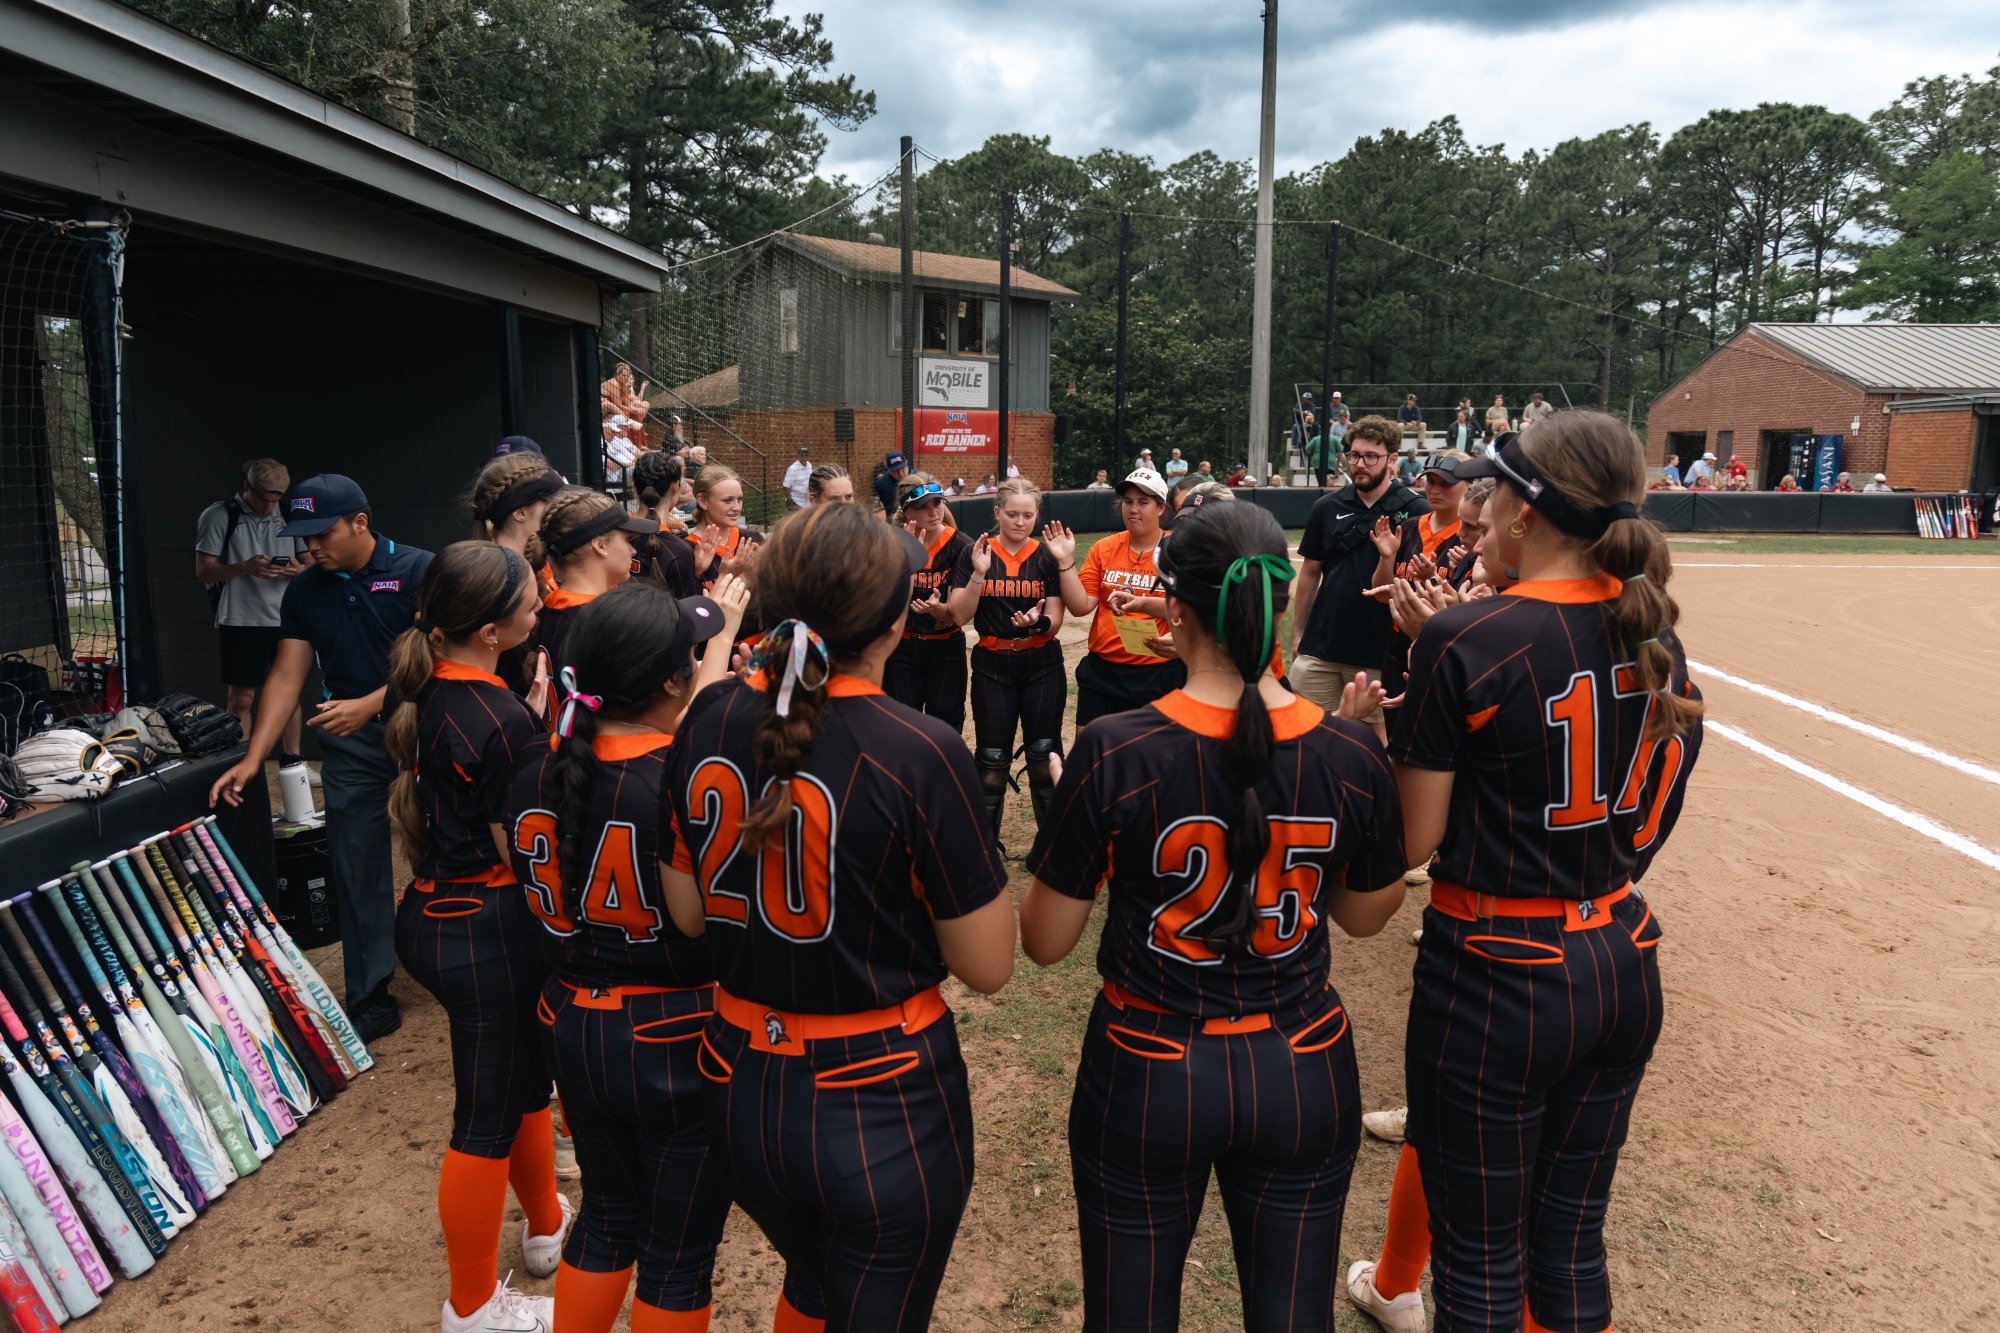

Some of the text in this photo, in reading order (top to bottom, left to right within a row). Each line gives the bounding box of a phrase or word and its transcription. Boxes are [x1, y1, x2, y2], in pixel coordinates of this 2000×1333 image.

[926, 370, 983, 389] MOBILE
[934, 364, 967, 372] UNIVERSITY
[925, 434, 986, 446] RED BANNER
[946, 412, 967, 424] NAIA
[370, 579, 401, 592] NAIA
[514, 808, 663, 944] 34
[686, 756, 837, 944] 20
[1147, 814, 1338, 966] 25
[225, 1008, 296, 1129] UNLIMITED
[308, 1012, 351, 1075] ECHO
[312, 987, 370, 1069] LOUISVILLE
[17, 1138, 106, 1290] UNLIMITED
[92, 1142, 164, 1249] LOUISVILLE
[100, 1122, 176, 1231] EASTON
